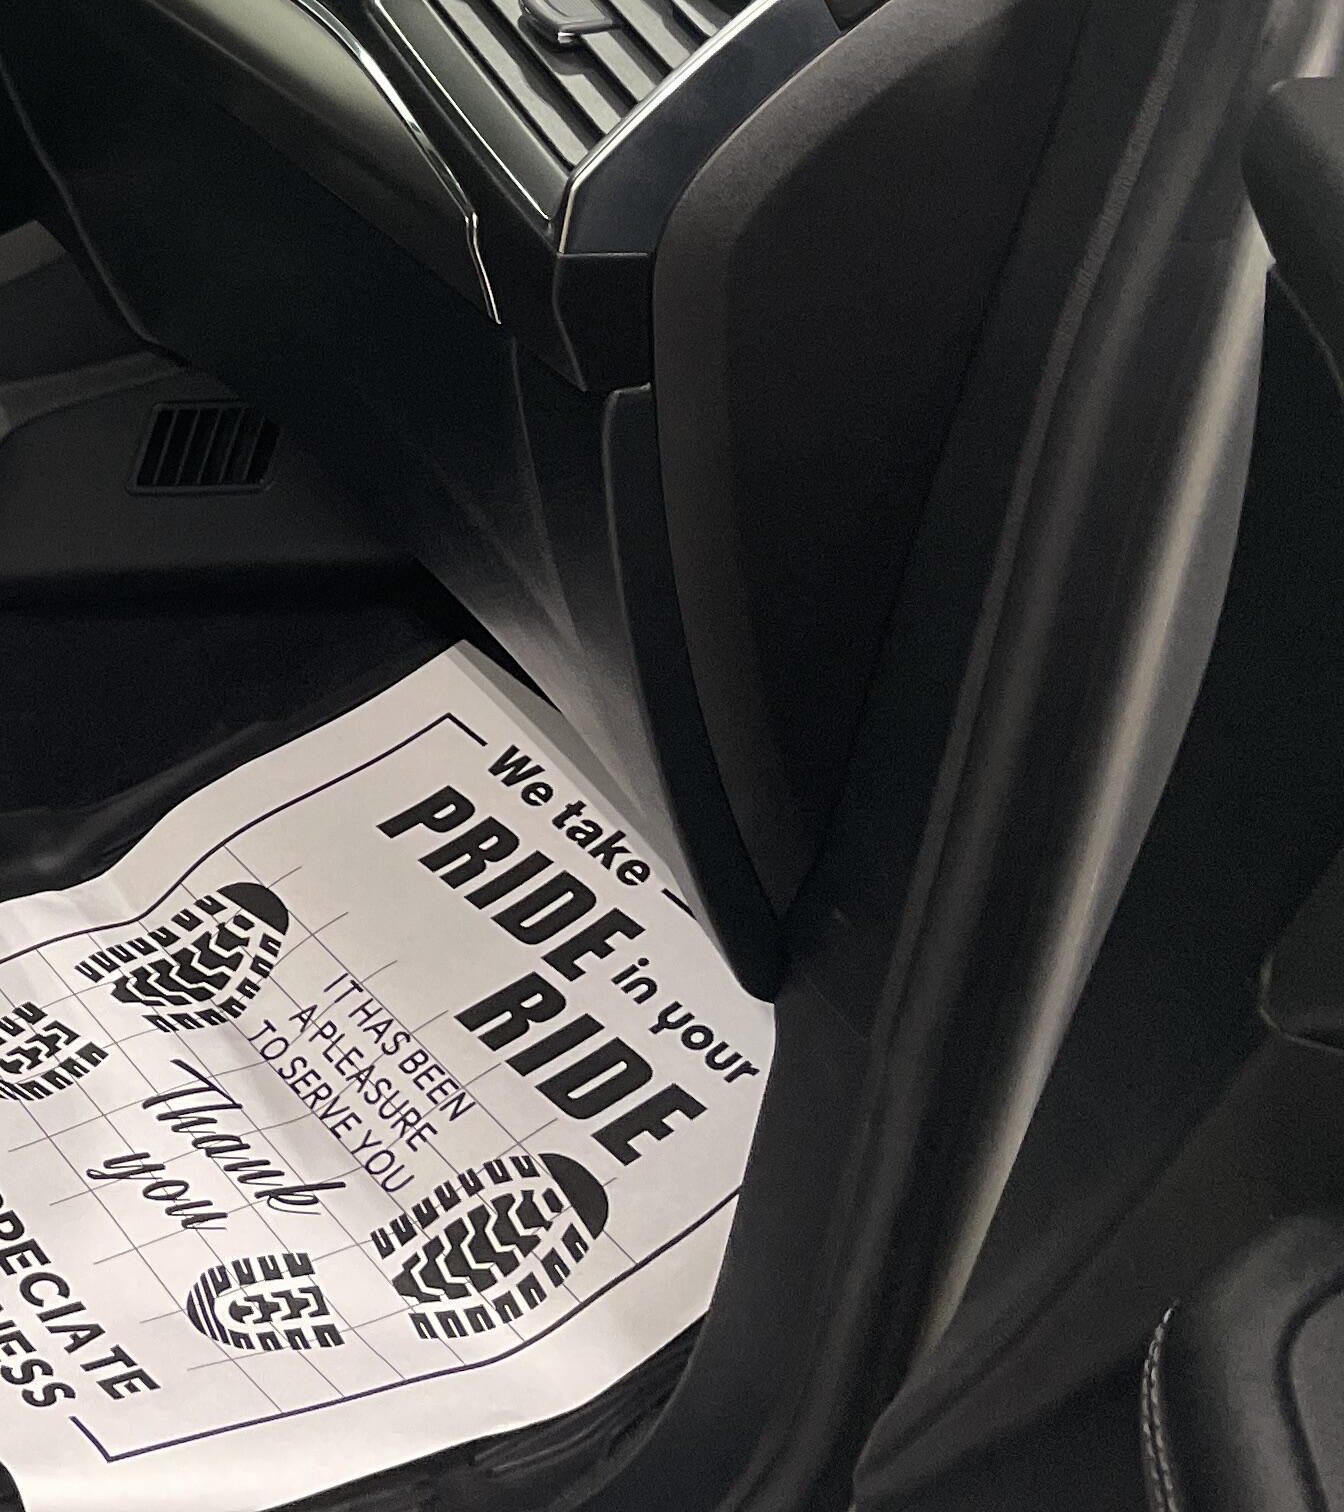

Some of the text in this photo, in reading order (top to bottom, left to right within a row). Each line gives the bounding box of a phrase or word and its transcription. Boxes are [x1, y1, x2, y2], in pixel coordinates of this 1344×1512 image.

[488, 744, 651, 886] We take
[375, 785, 760, 1083] PRIDE in your
[246, 1019, 415, 1193] TO SERVE YOU
[289, 1004, 438, 1152] A PLEASURE
[323, 972, 476, 1122] IT HAS BEEN
[453, 971, 708, 1167] RIDE
[86, 1152, 228, 1230] you
[142, 1059, 347, 1217] Thank
